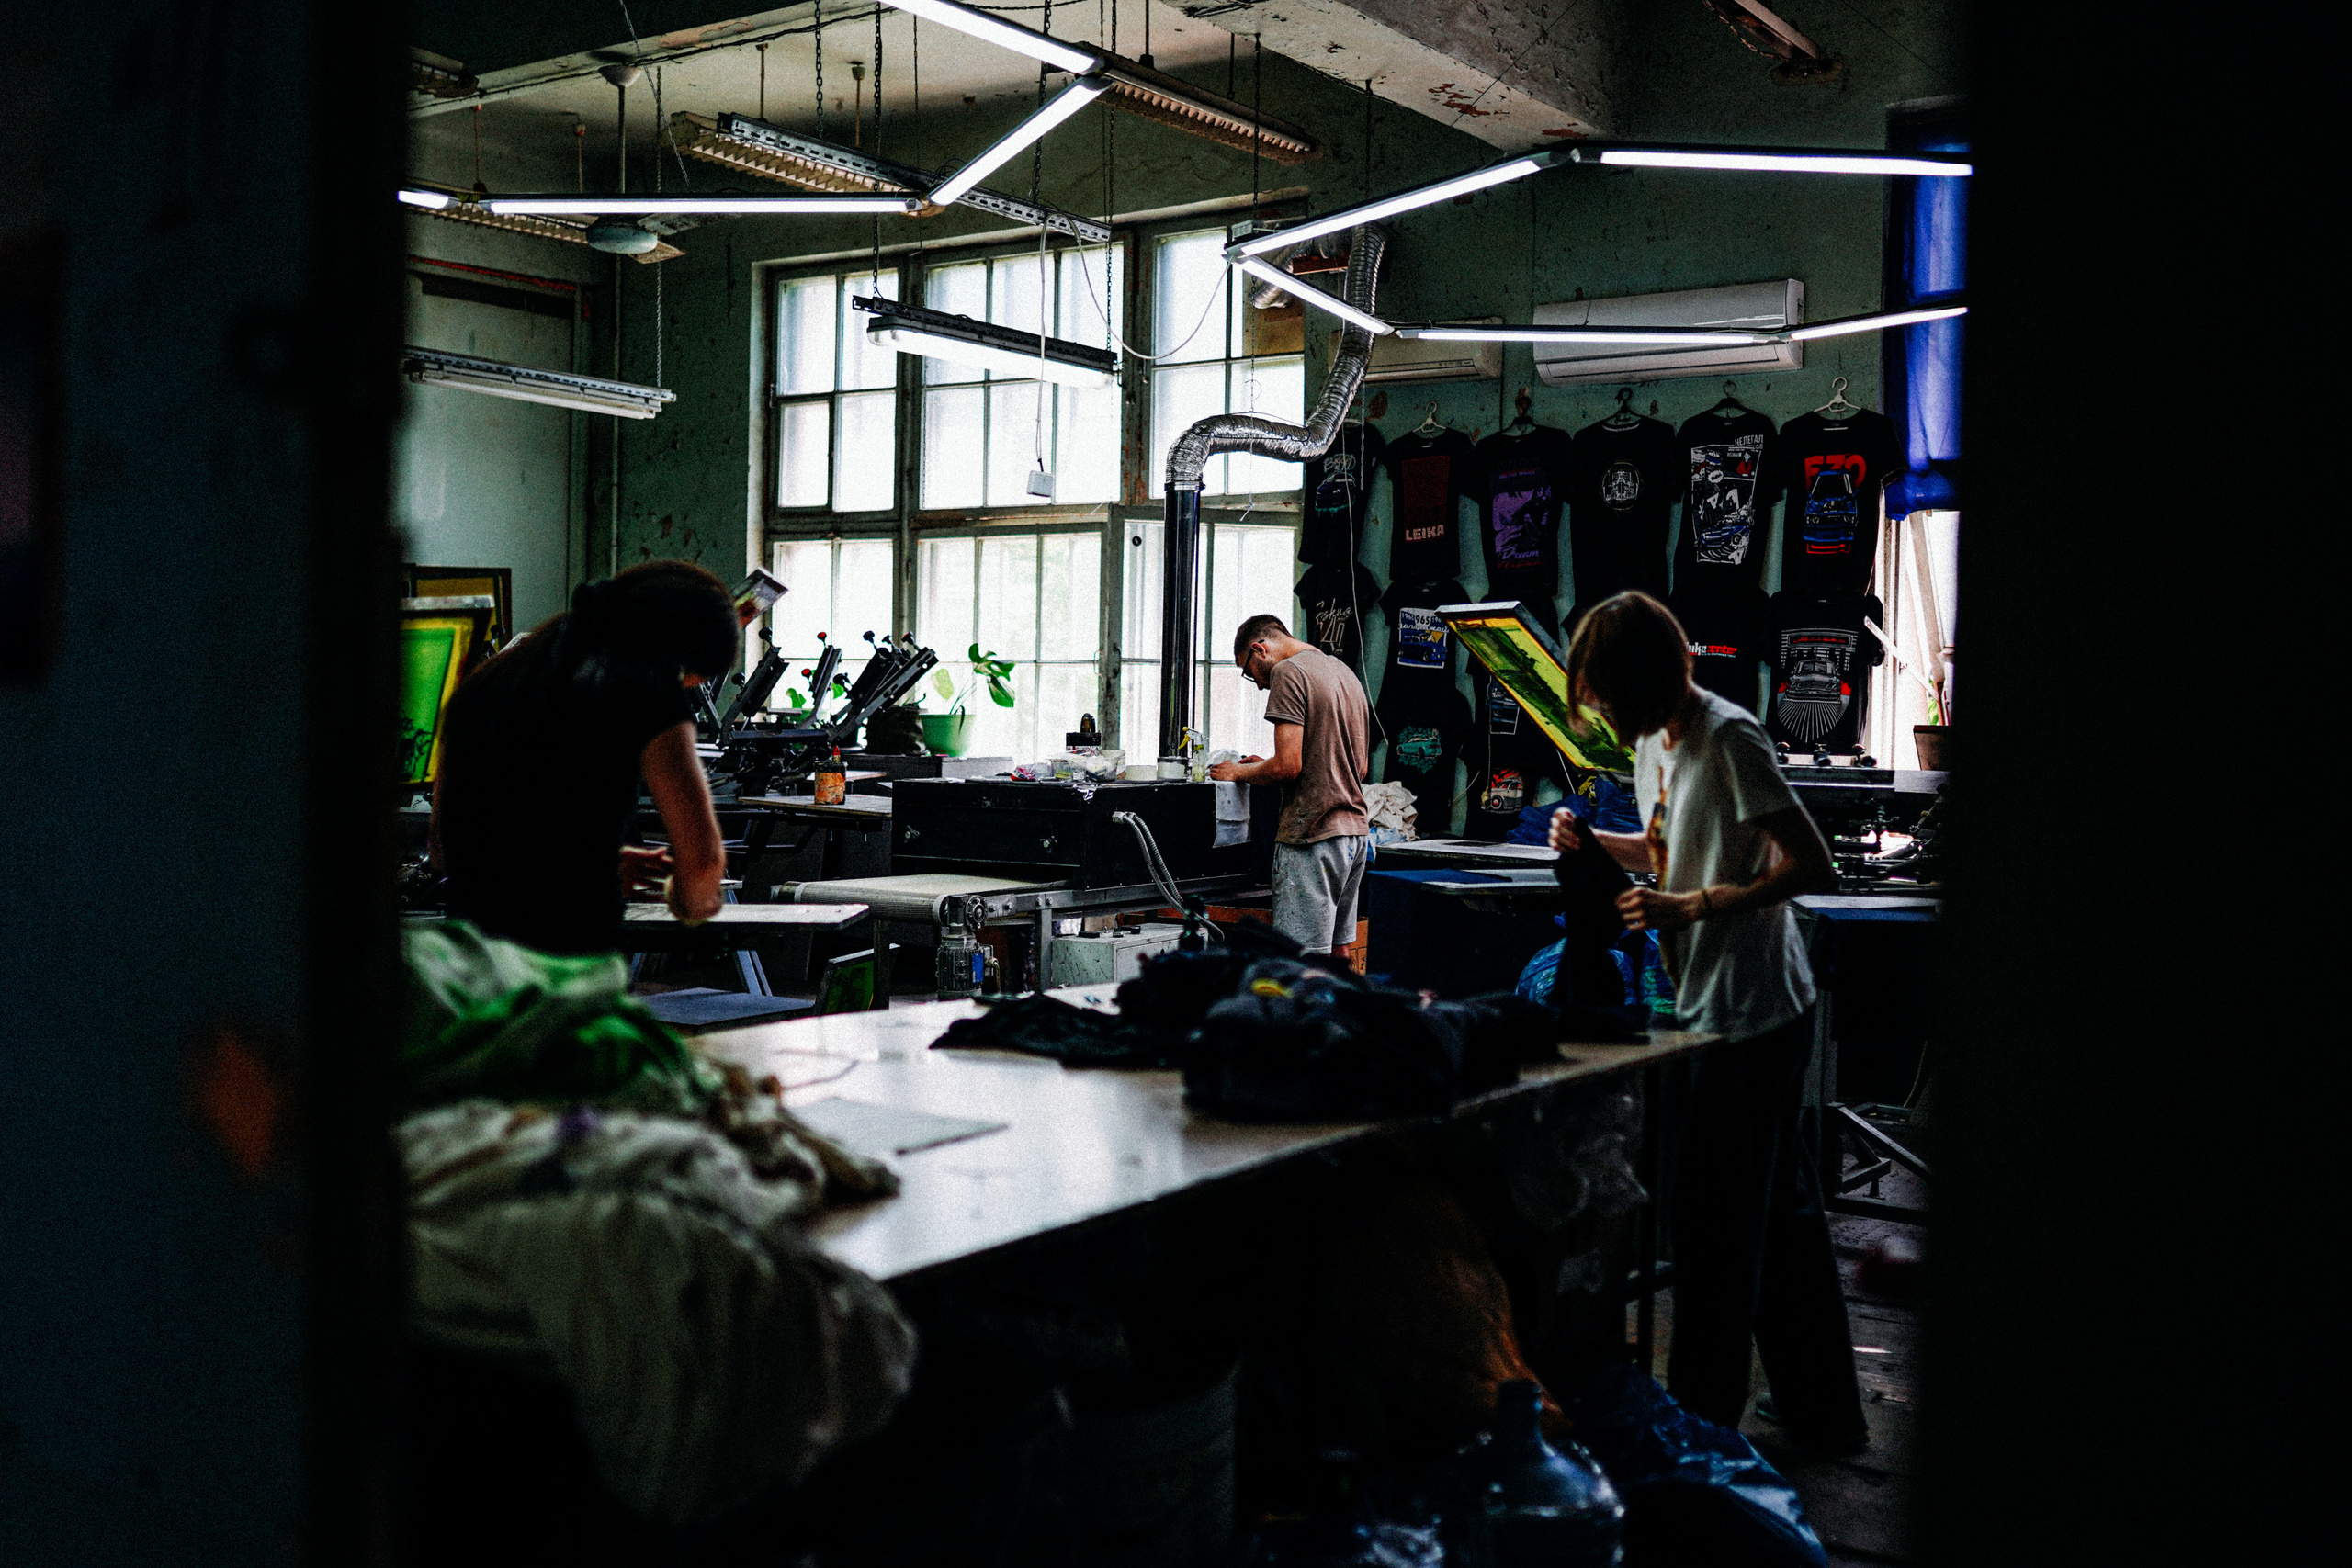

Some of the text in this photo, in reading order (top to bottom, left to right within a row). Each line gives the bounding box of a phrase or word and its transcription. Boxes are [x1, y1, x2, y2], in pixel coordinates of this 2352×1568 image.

[1735, 434, 1764, 447] НЕЛЕГАЛ
[1406, 524, 1445, 541] LEIKA
[1415, 615, 1430, 625] 965
